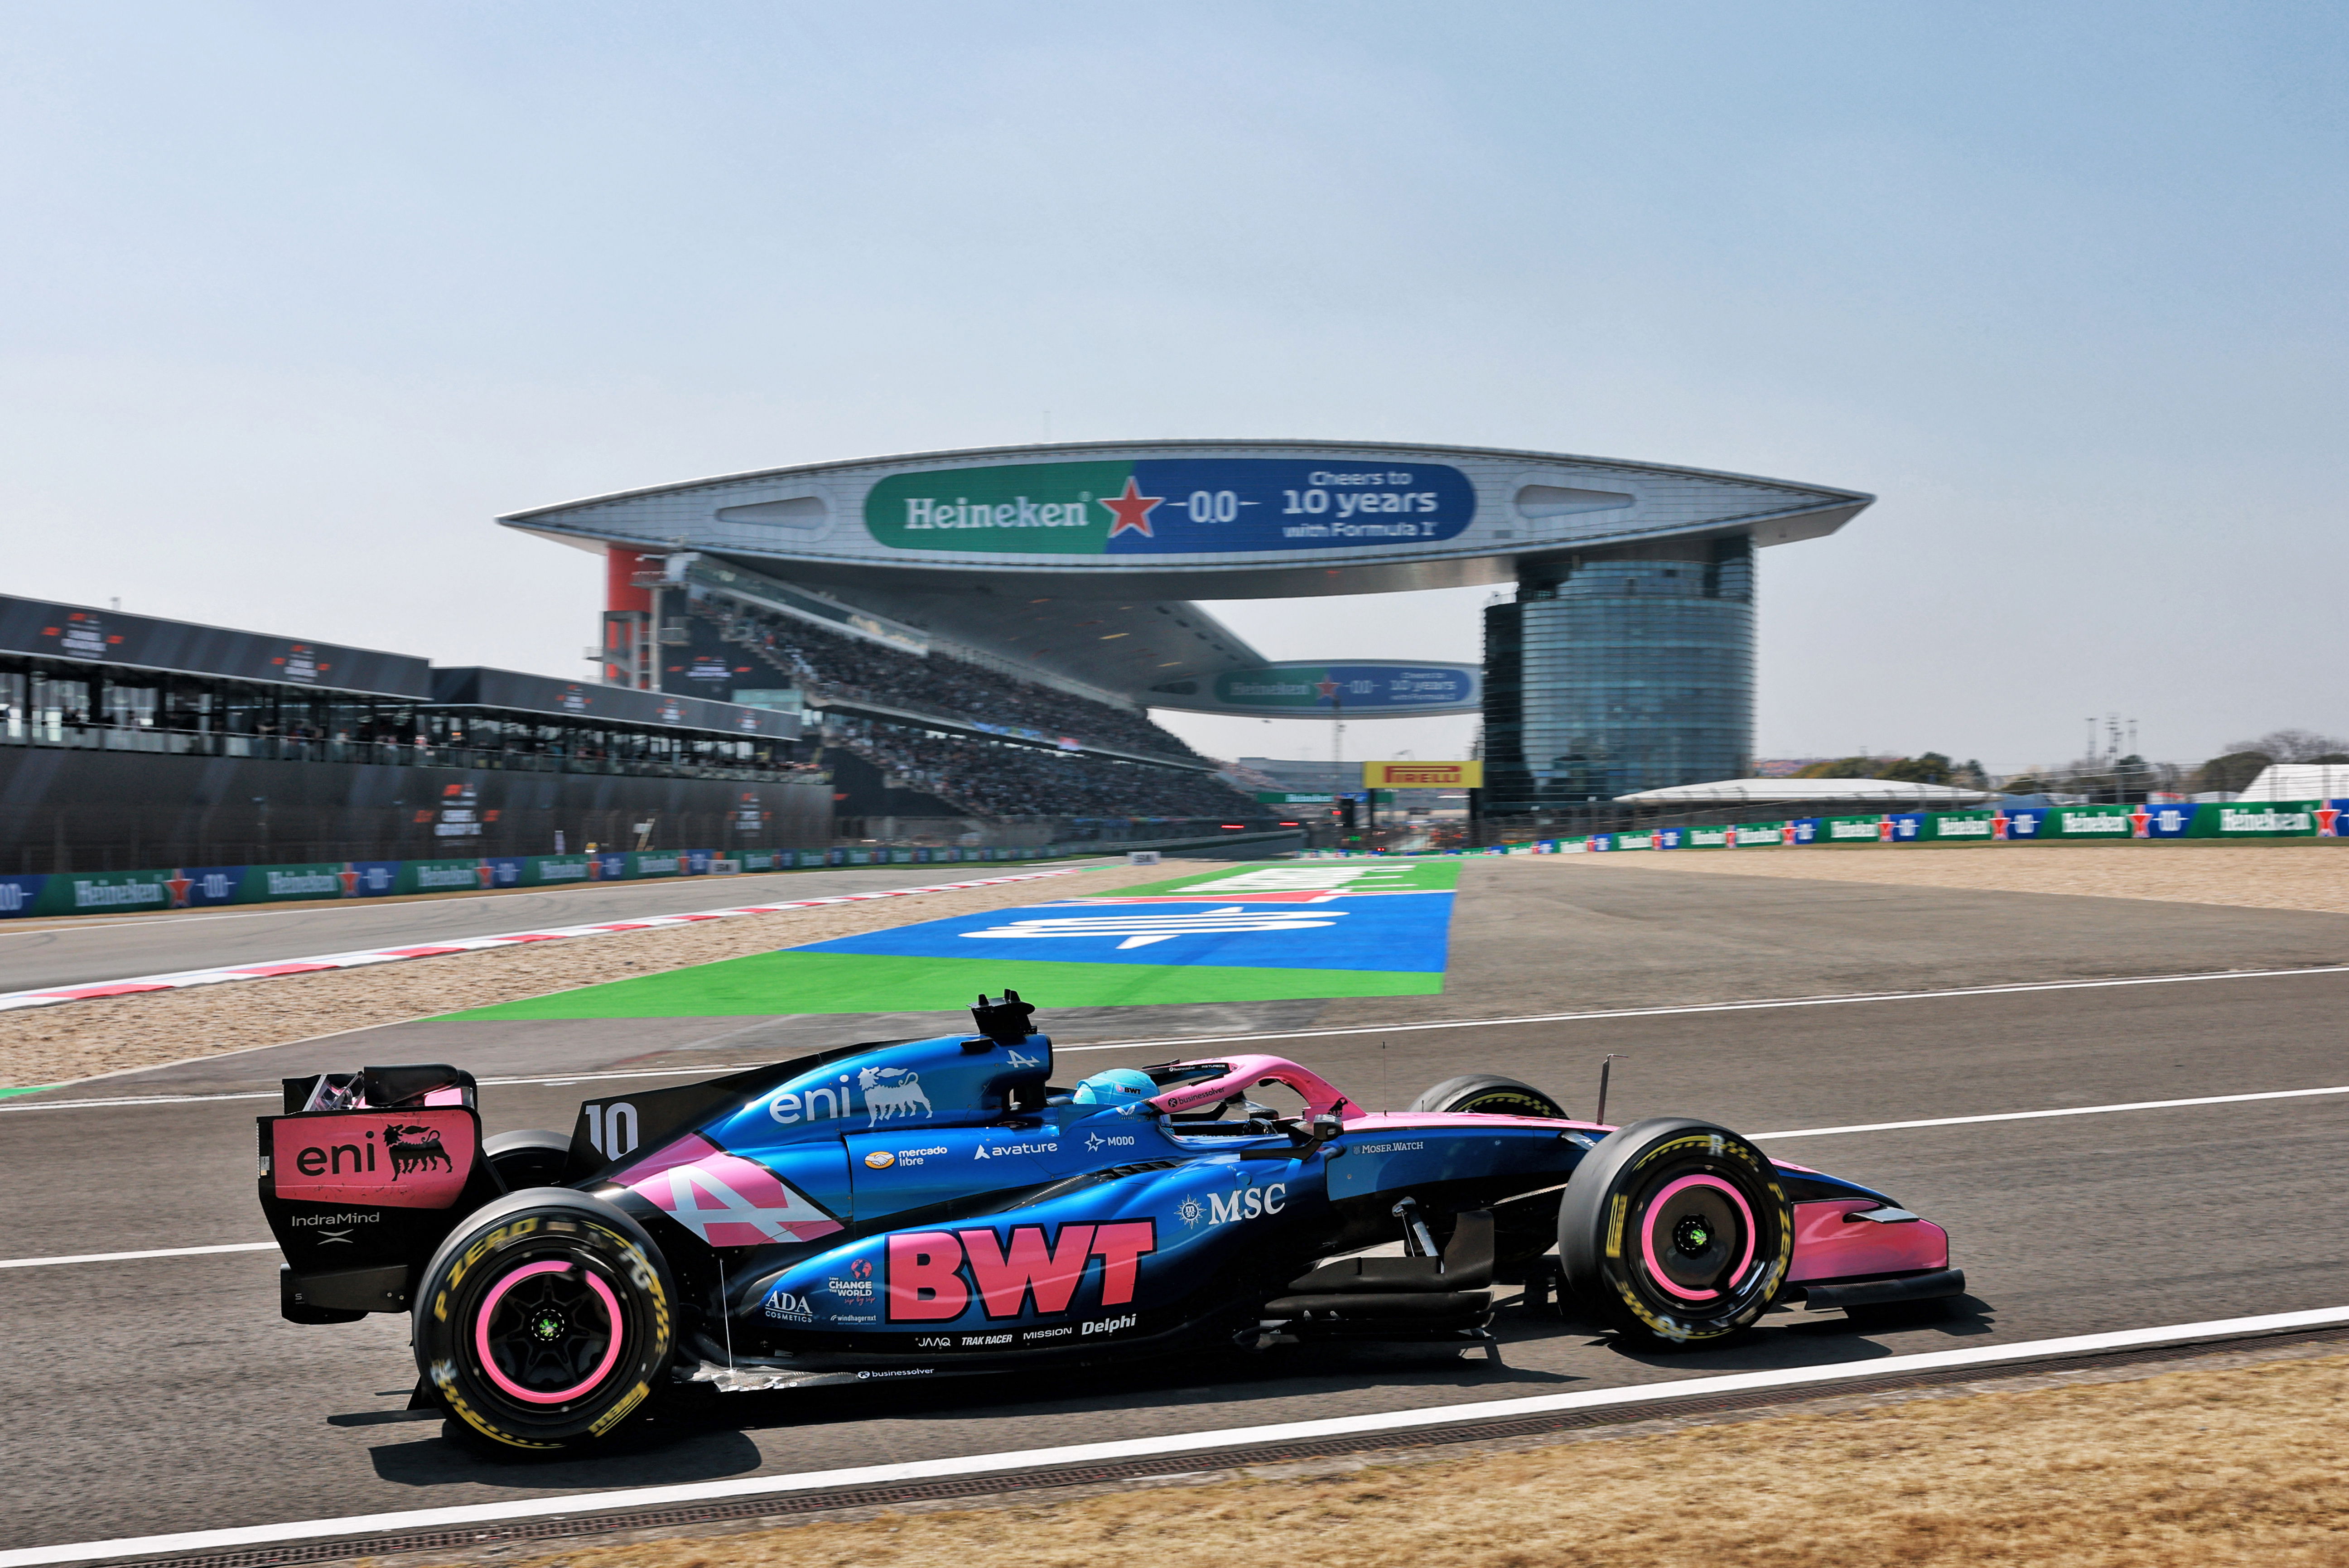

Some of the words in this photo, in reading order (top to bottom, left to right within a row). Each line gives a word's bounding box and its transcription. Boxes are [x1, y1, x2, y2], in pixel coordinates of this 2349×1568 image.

[1308, 472, 1384, 485] Cheers
[1387, 472, 1413, 484] to
[1282, 489, 1330, 514] 10
[1335, 492, 1438, 517] years
[903, 497, 1090, 529] Heineken
[1283, 524, 1329, 537] with
[1331, 522, 1418, 536] Formula
[1383, 766, 1462, 783] PIRELLI
[769, 1074, 850, 1124] eni
[1178, 1087, 1225, 1105] businessolver
[585, 1102, 638, 1161] 10
[1107, 1136, 1134, 1146] MODO
[1361, 1142, 1424, 1154] MOSER.WATCH
[297, 1130, 375, 1176] eni
[898, 1146, 948, 1158] mercado
[992, 1142, 1058, 1156] avature
[899, 1156, 924, 1167] libre
[1207, 1183, 1286, 1225] MSC
[292, 1212, 380, 1226] IndraMind
[447, 1217, 539, 1291] ZERO
[887, 1219, 1155, 1323] BWT
[766, 1290, 812, 1313] ADA
[857, 1295, 863, 1306] by
[766, 1311, 812, 1322] COSMETICS
[1082, 1313, 1136, 1335] Delphi
[962, 1336, 984, 1346] TRAK
[985, 1334, 1012, 1344] RACER
[1023, 1327, 1072, 1340] MISSION
[872, 1368, 934, 1377] businessolver
